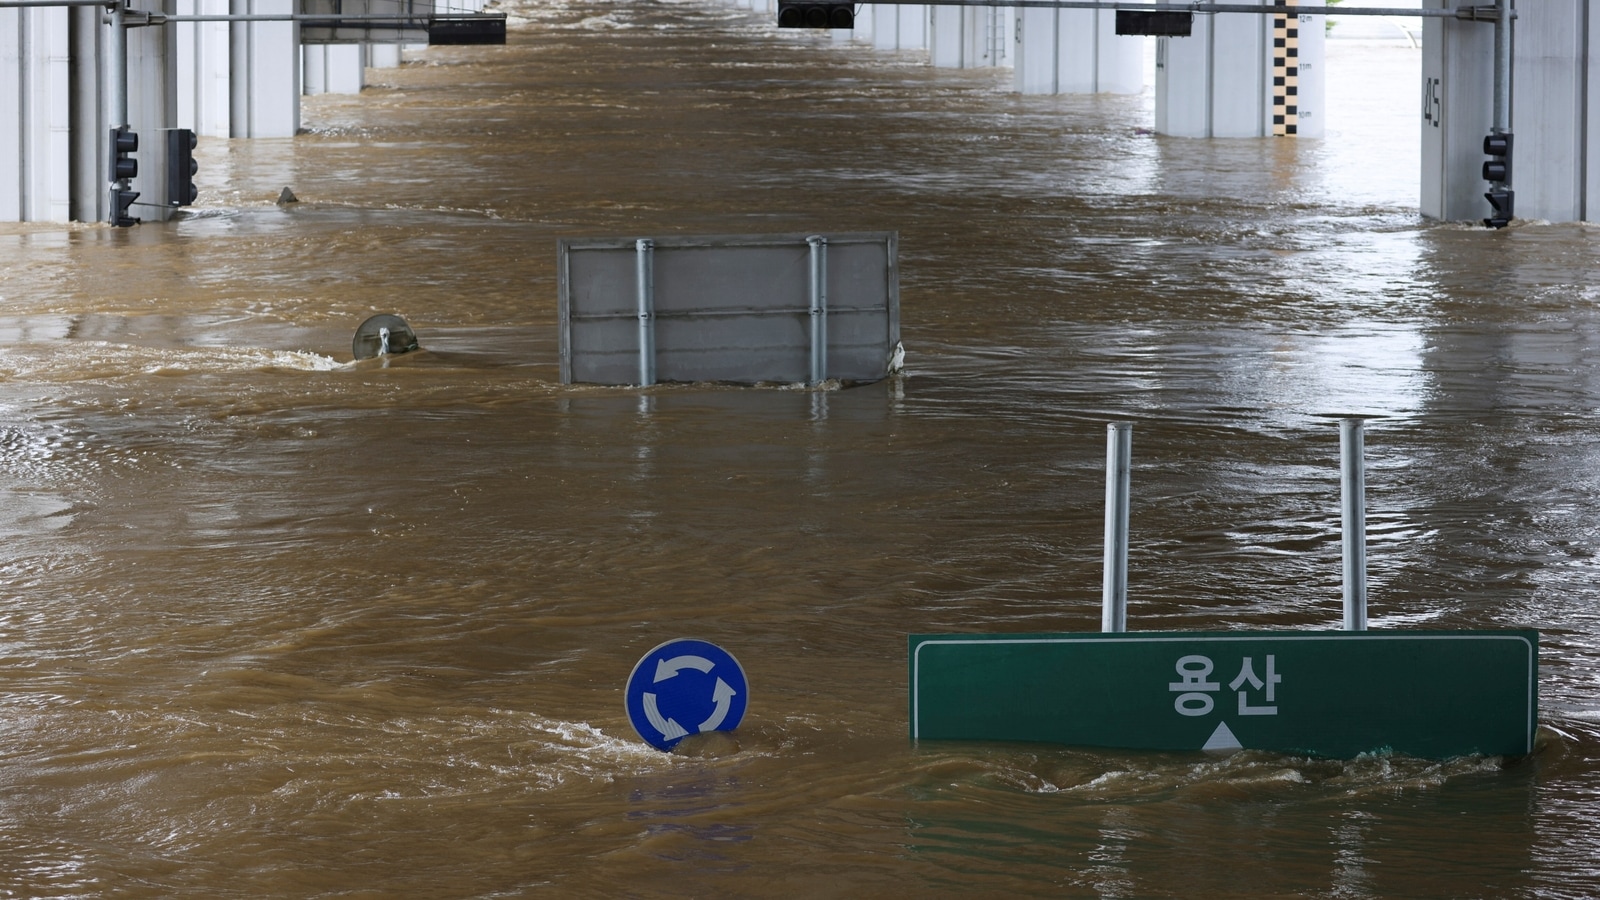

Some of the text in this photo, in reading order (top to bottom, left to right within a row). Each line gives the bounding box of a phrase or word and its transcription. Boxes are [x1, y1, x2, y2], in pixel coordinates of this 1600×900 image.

[1299, 15, 1312, 23] 12m
[1299, 63, 1312, 71] 11m
[1424, 77, 1440, 128] 45
[1298, 111, 1312, 119] 10m
[1168, 654, 1281, 717] 용산
